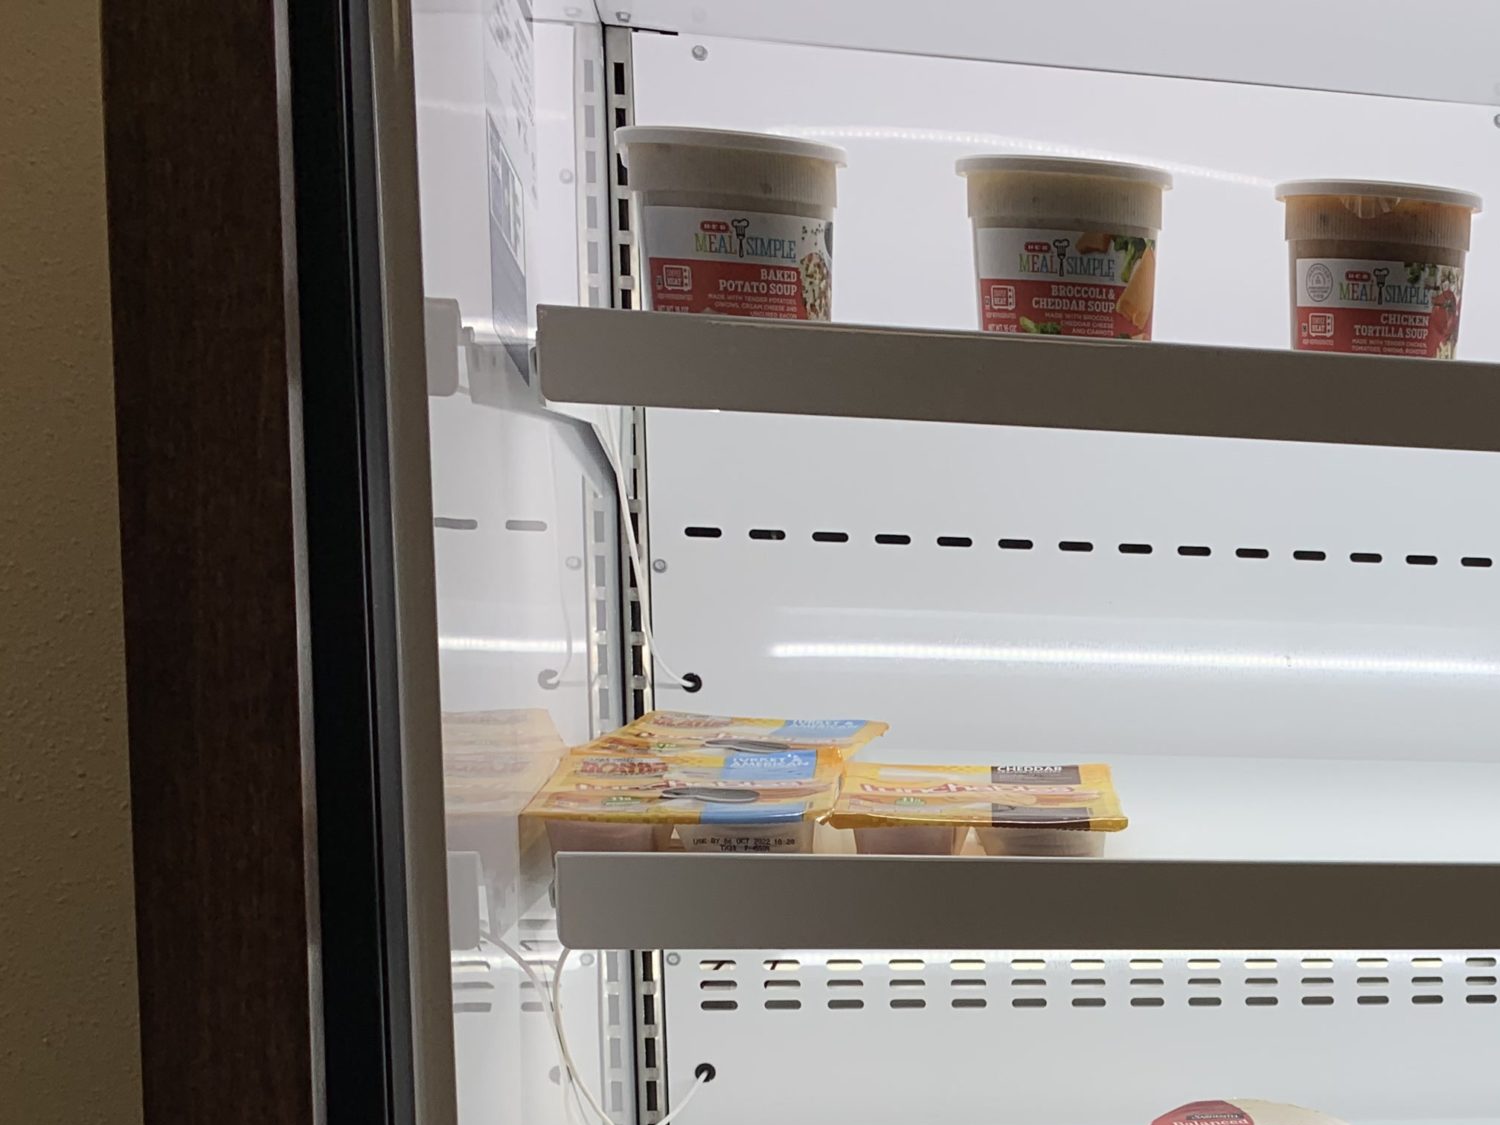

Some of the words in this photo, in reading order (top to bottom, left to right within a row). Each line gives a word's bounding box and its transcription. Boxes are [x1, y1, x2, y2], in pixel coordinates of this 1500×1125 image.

[694, 233, 738, 254] MEAL
[746, 237, 796, 259] SIMPLE
[1019, 253, 1058, 273] MEAL
[1067, 257, 1114, 278] SIMPLE
[761, 269, 797, 282] BAKED
[719, 280, 767, 293] POTATO
[770, 284, 797, 296] SOUP
[1051, 285, 1108, 298] BROCCOLI
[1108, 288, 1115, 299] &
[1339, 283, 1376, 301] MEAL
[1385, 285, 1429, 305] SIMPLE
[1032, 299, 1085, 310] CHEDDAR
[1088, 301, 1115, 312] SOUP
[1381, 314, 1429, 326] CHICKEN
[1354, 325, 1403, 337] TORTILLA
[1405, 328, 1428, 339] SOUP
